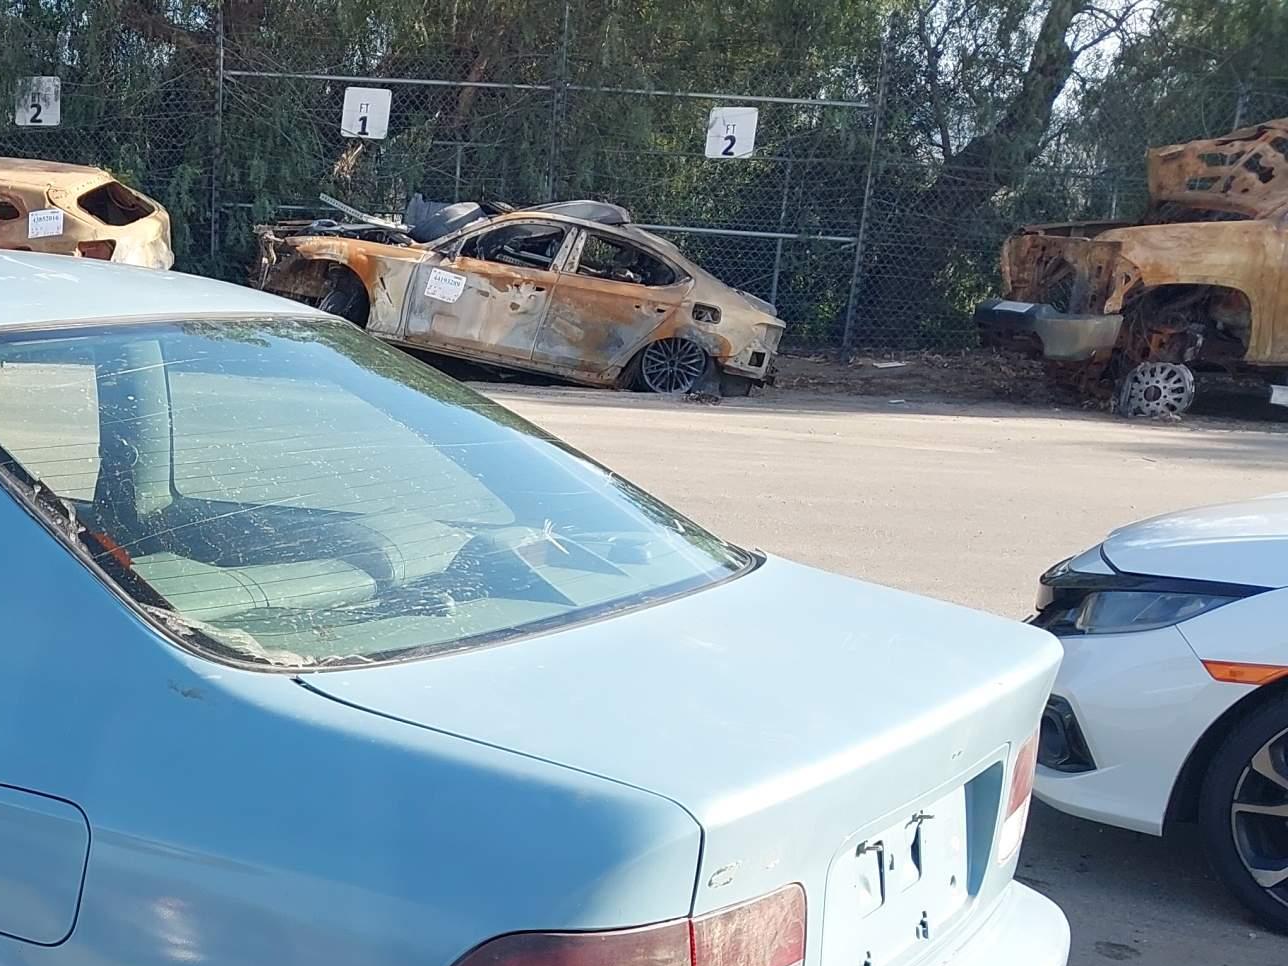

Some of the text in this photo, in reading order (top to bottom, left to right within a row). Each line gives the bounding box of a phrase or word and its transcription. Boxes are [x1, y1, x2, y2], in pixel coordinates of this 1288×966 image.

[30, 103, 43, 123] 2
[359, 103, 369, 113] FT
[357, 116, 369, 136] 1
[726, 124, 736, 134] FT
[722, 135, 736, 156] 2
